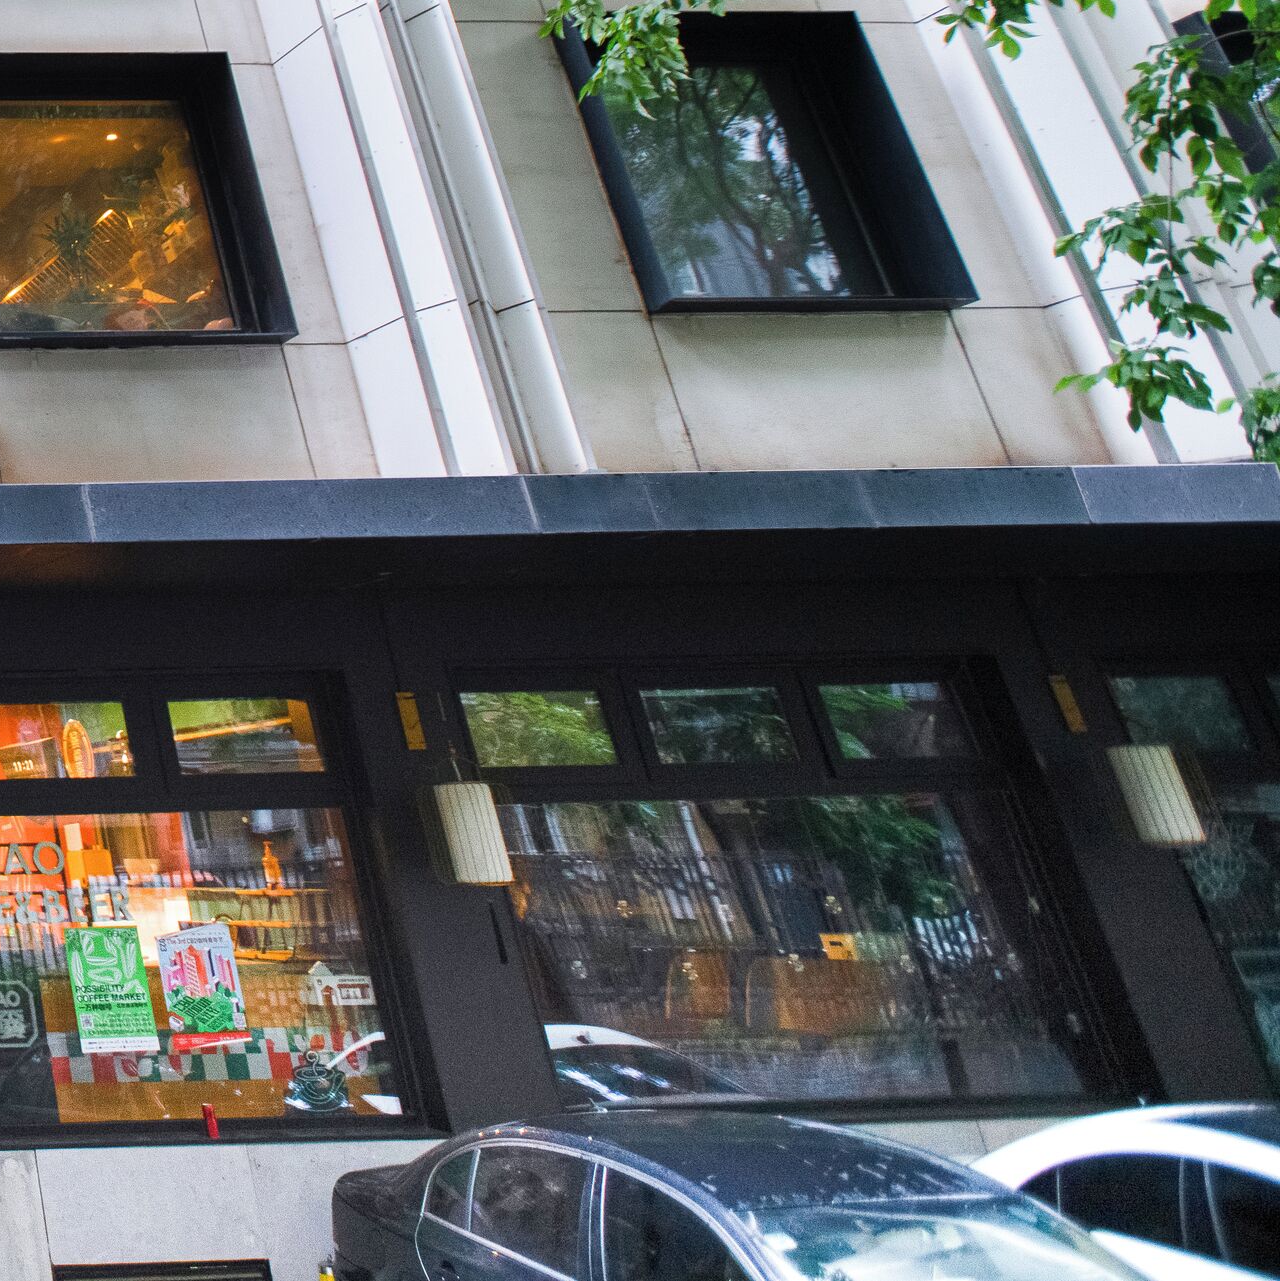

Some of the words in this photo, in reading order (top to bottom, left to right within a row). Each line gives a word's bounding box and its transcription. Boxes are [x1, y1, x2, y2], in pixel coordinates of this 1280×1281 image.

[75, 984, 125, 994] POSSIBILITY
[76, 993, 110, 1003] COFFEE
[111, 992, 147, 1002] MARKET
